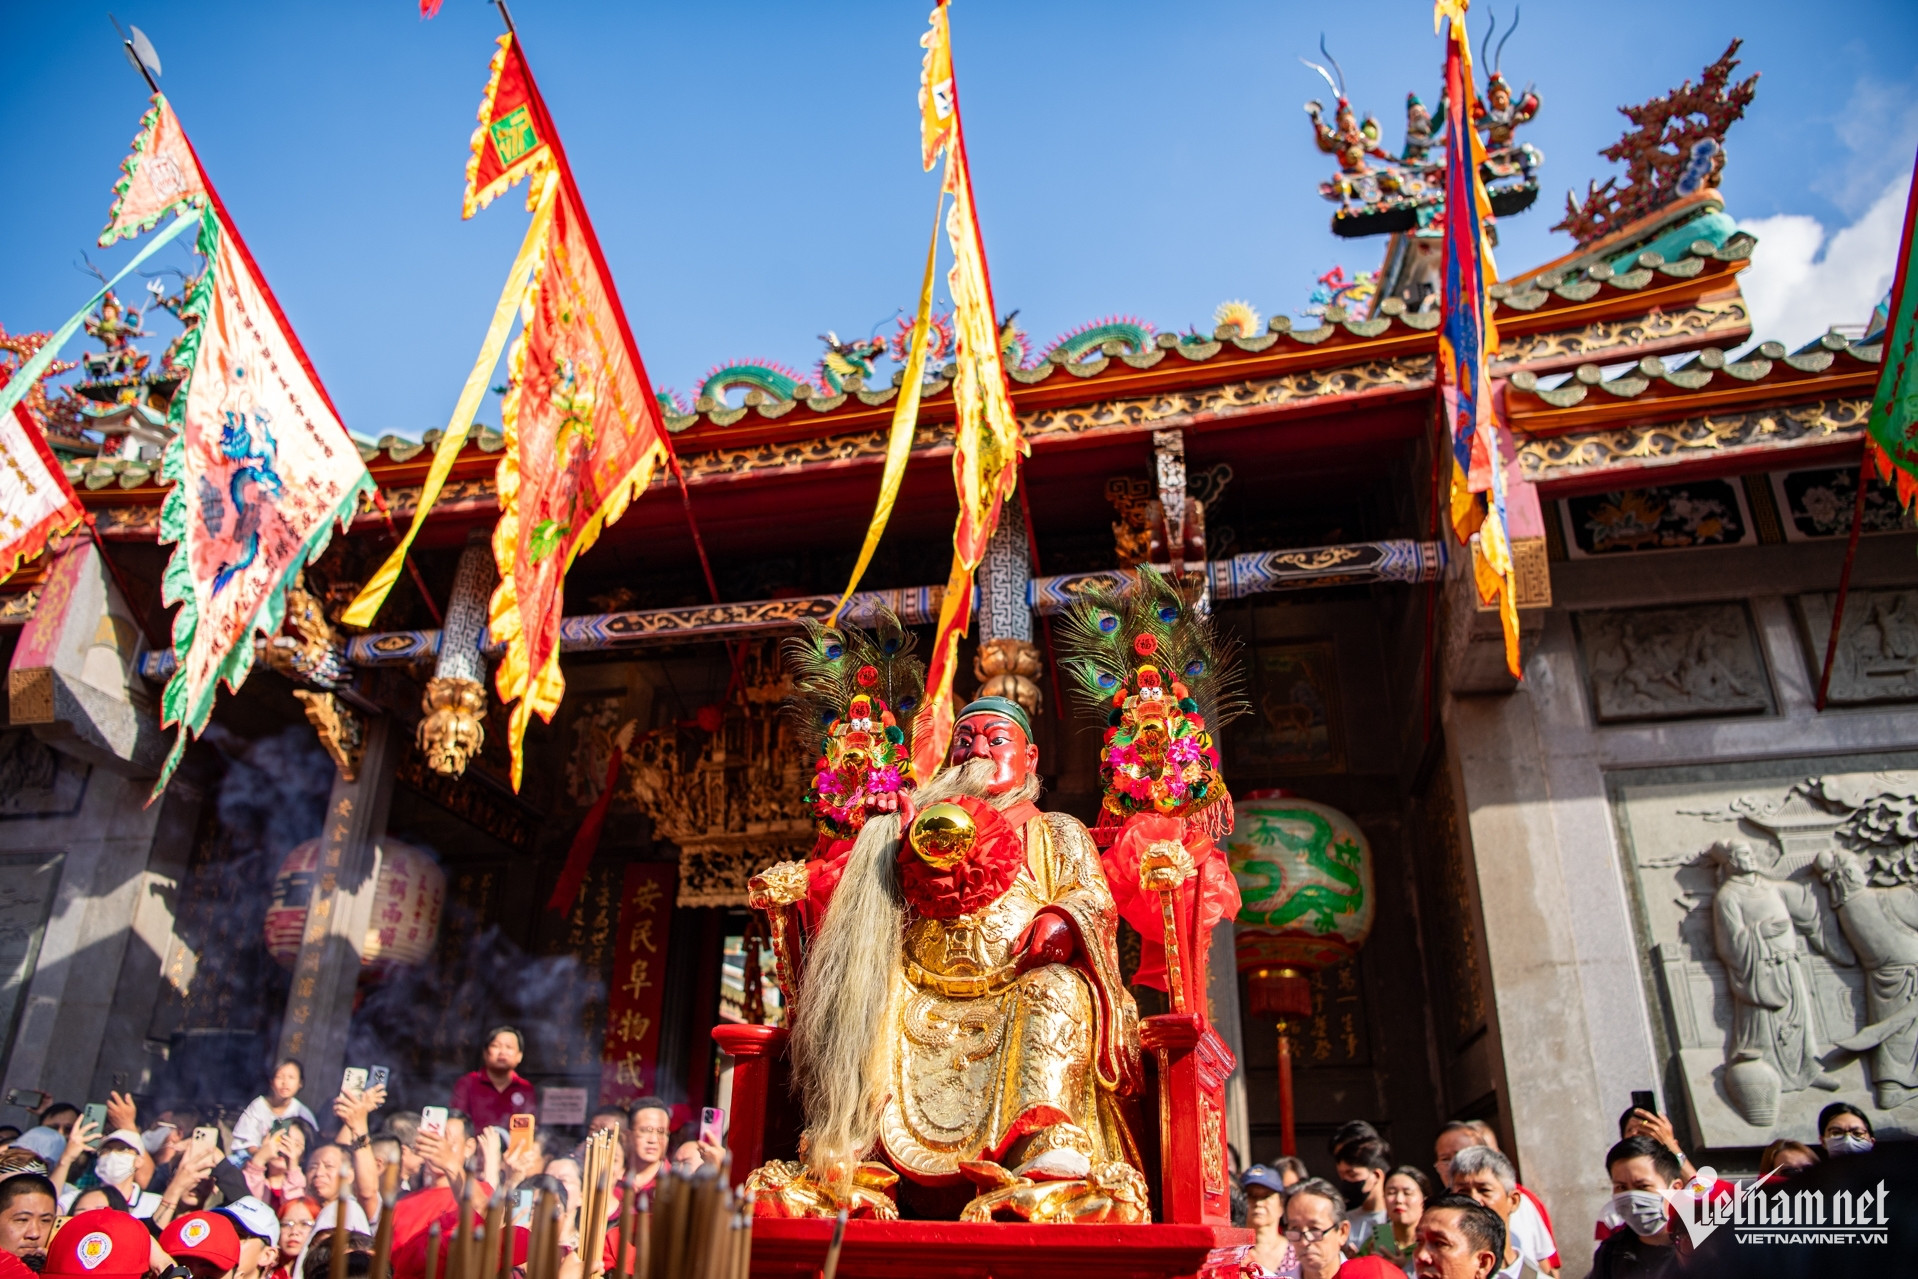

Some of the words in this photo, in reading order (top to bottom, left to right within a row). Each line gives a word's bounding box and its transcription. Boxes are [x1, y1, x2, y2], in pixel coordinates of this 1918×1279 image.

[616, 878, 663, 1112] 安民阜物咸
